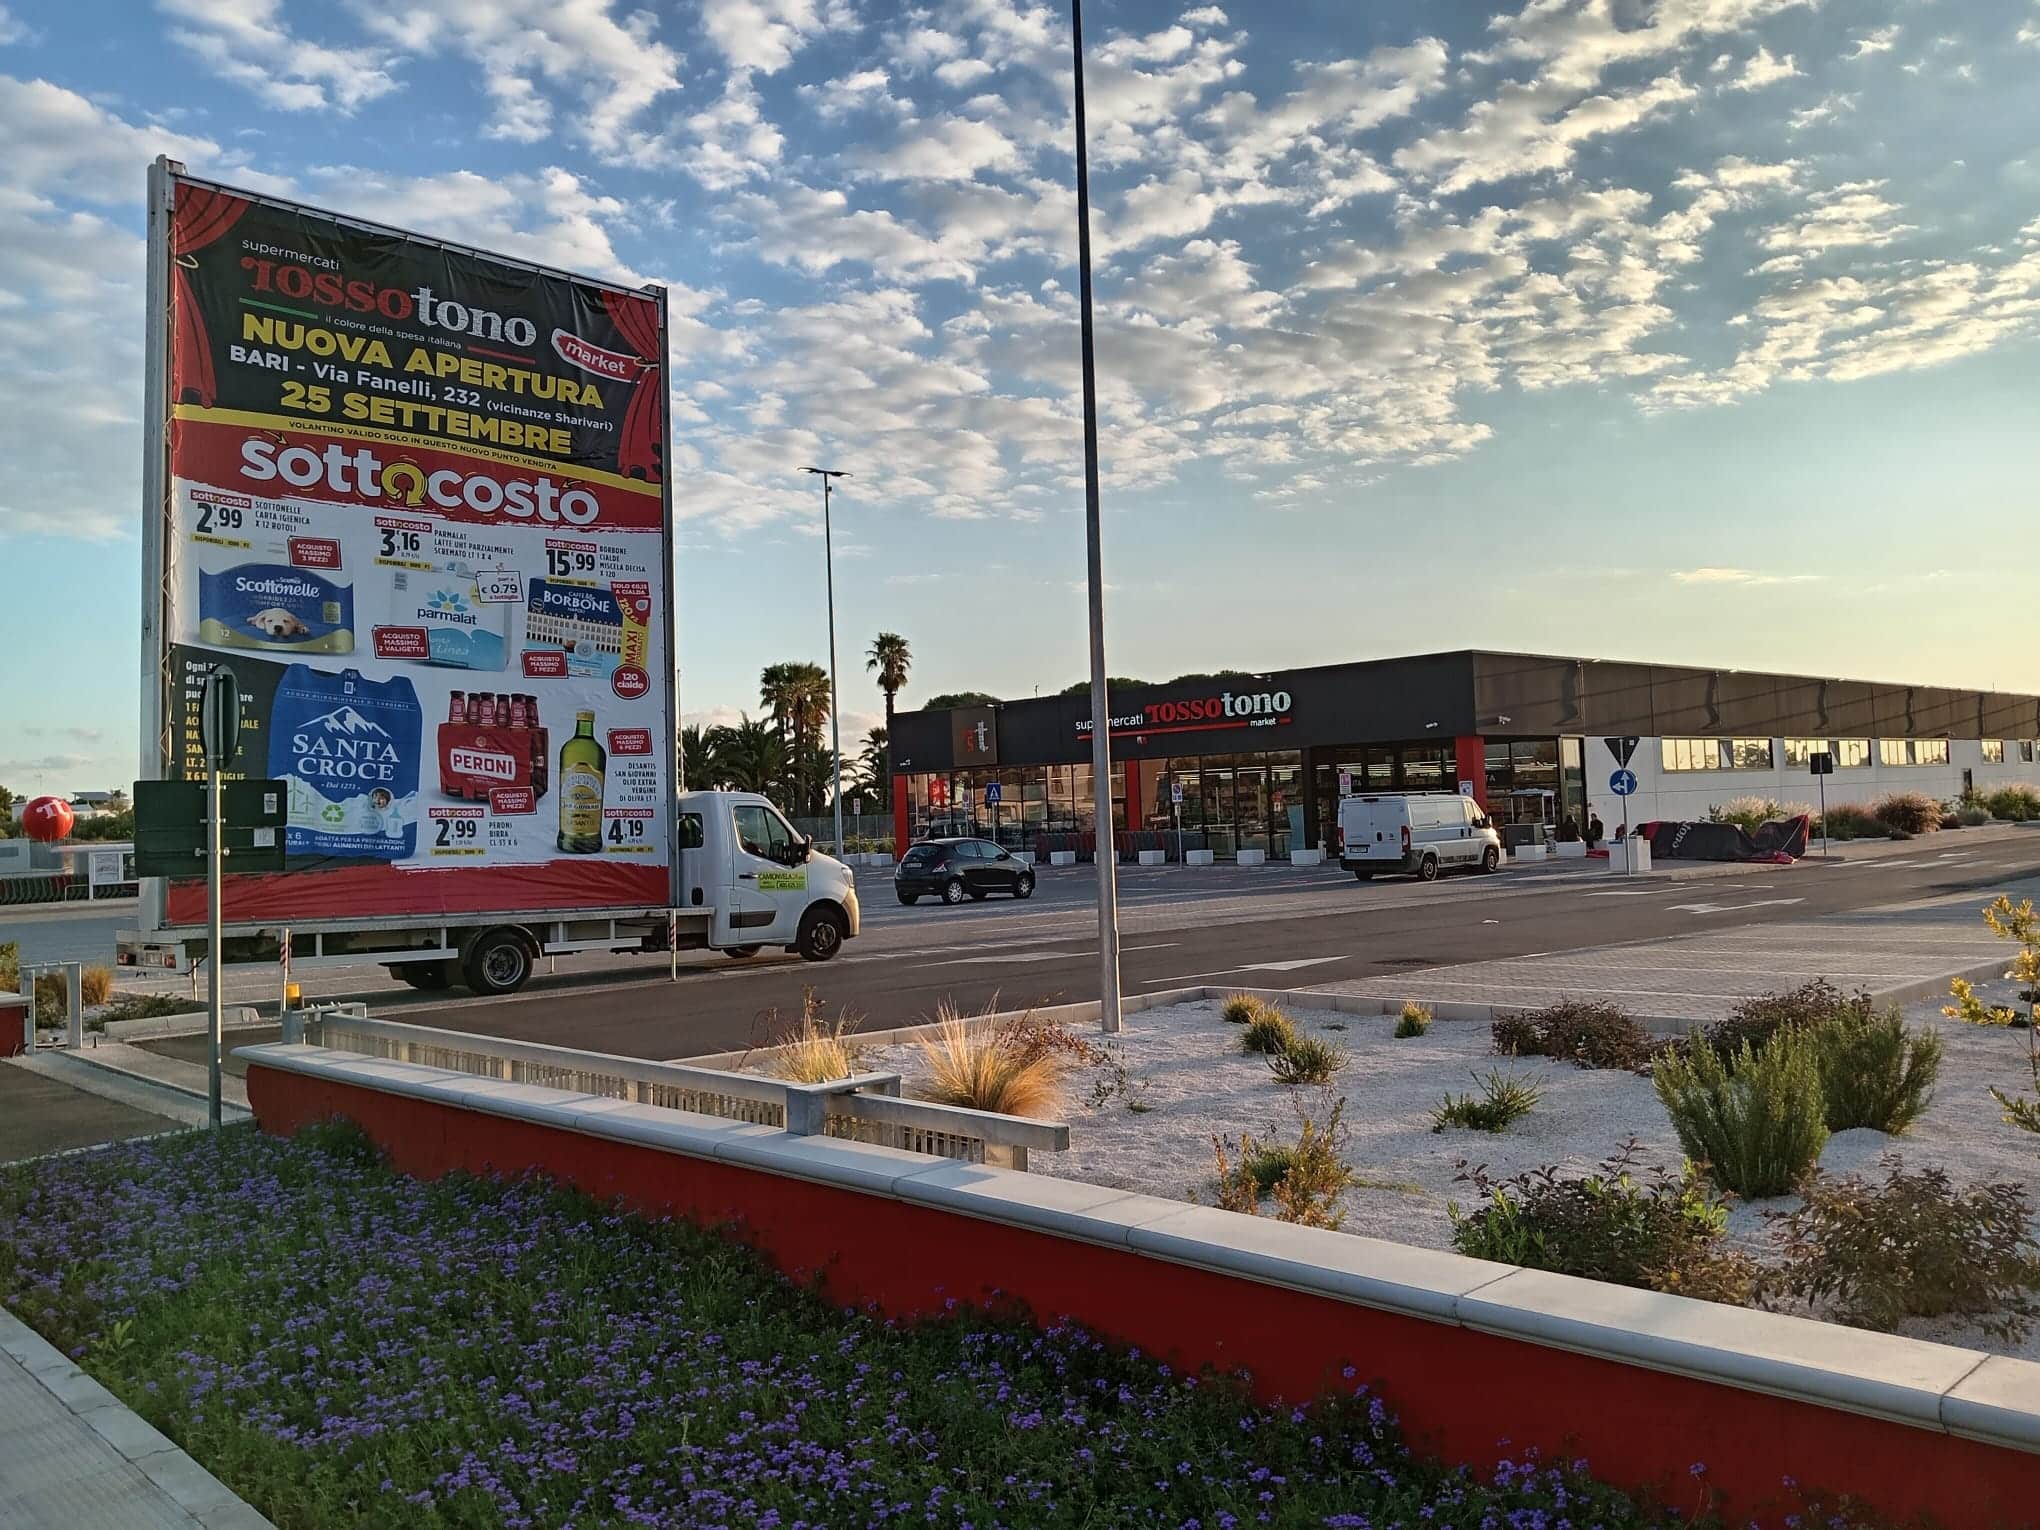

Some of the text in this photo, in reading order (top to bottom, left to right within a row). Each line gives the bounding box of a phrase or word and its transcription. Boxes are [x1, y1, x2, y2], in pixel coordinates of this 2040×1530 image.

[242, 239, 340, 271] supermercati
[325, 315, 462, 350] il colore della spesa italiana
[243, 312, 605, 410] NUOVA APERTURA
[565, 341, 626, 375] market
[230, 344, 290, 372] BARI
[312, 362, 349, 384] Via
[357, 370, 437, 401] Fanelli,
[443, 386, 481, 407] 232
[487, 399, 551, 421] (vicinanze
[555, 412, 614, 433] Sharivari)
[280, 380, 572, 455] 25 SETTEMBRE
[288, 420, 557, 471] VOLANTINO VALIDO SOLO IN QUESTO NUOVO PUNTO VENDITA
[240, 440, 599, 525] sottocosto
[191, 490, 250, 508] sottocosto
[255, 501, 301, 515] SCOTTONELLE
[255, 510, 310, 525] CARTA IGIENICA
[262, 521, 270, 530] 12
[271, 522, 297, 533] ROTOLI
[375, 517, 431, 532] sottocosto
[434, 529, 468, 541] PARMALAT
[296, 543, 333, 552] ACQUISTO
[434, 538, 515, 556] LATTE UHT PARZIALMENTE
[546, 540, 597, 553] sottocosto
[600, 545, 627, 555] BORBONE
[298, 549, 332, 558] MASSIMO
[434, 546, 467, 559] SCREMATO
[468, 551, 476, 559] LT
[487, 553, 492, 561] 4
[600, 554, 620, 562] CIALDE
[600, 562, 646, 573] MISCELA DECISA
[235, 576, 321, 599] Scottonelle
[481, 583, 518, 595] € 0.79
[543, 590, 611, 614] BORBONE
[417, 607, 478, 626] parmalat
[382, 632, 421, 640] ACQUISTO
[384, 639, 419, 647] MASSIMO
[384, 645, 425, 653] VALIGETTE
[624, 630, 638, 664] MAXI
[185, 661, 207, 673] Ogni
[185, 674, 195, 685] di
[622, 672, 639, 681] 120
[616, 680, 645, 690] cialde
[186, 702, 190, 712] 1
[1075, 712, 1144, 732] supmercati
[1250, 716, 1277, 728] market
[292, 733, 401, 763] SANTA
[186, 758, 206, 768] LT. 2
[297, 757, 395, 781] CROCE
[453, 754, 513, 775] PERONI
[628, 762, 657, 770] DESANTIS
[193, 772, 200, 781] 6
[614, 770, 657, 778] SAN GIOVANNI
[622, 778, 637, 786] OLIO
[619, 794, 626, 802] DI
[430, 809, 483, 817] sottocosto
[605, 809, 652, 818] sottocosto
[488, 821, 513, 830] PERONI
[295, 832, 302, 840] 6
[489, 830, 509, 838] BIRRA
